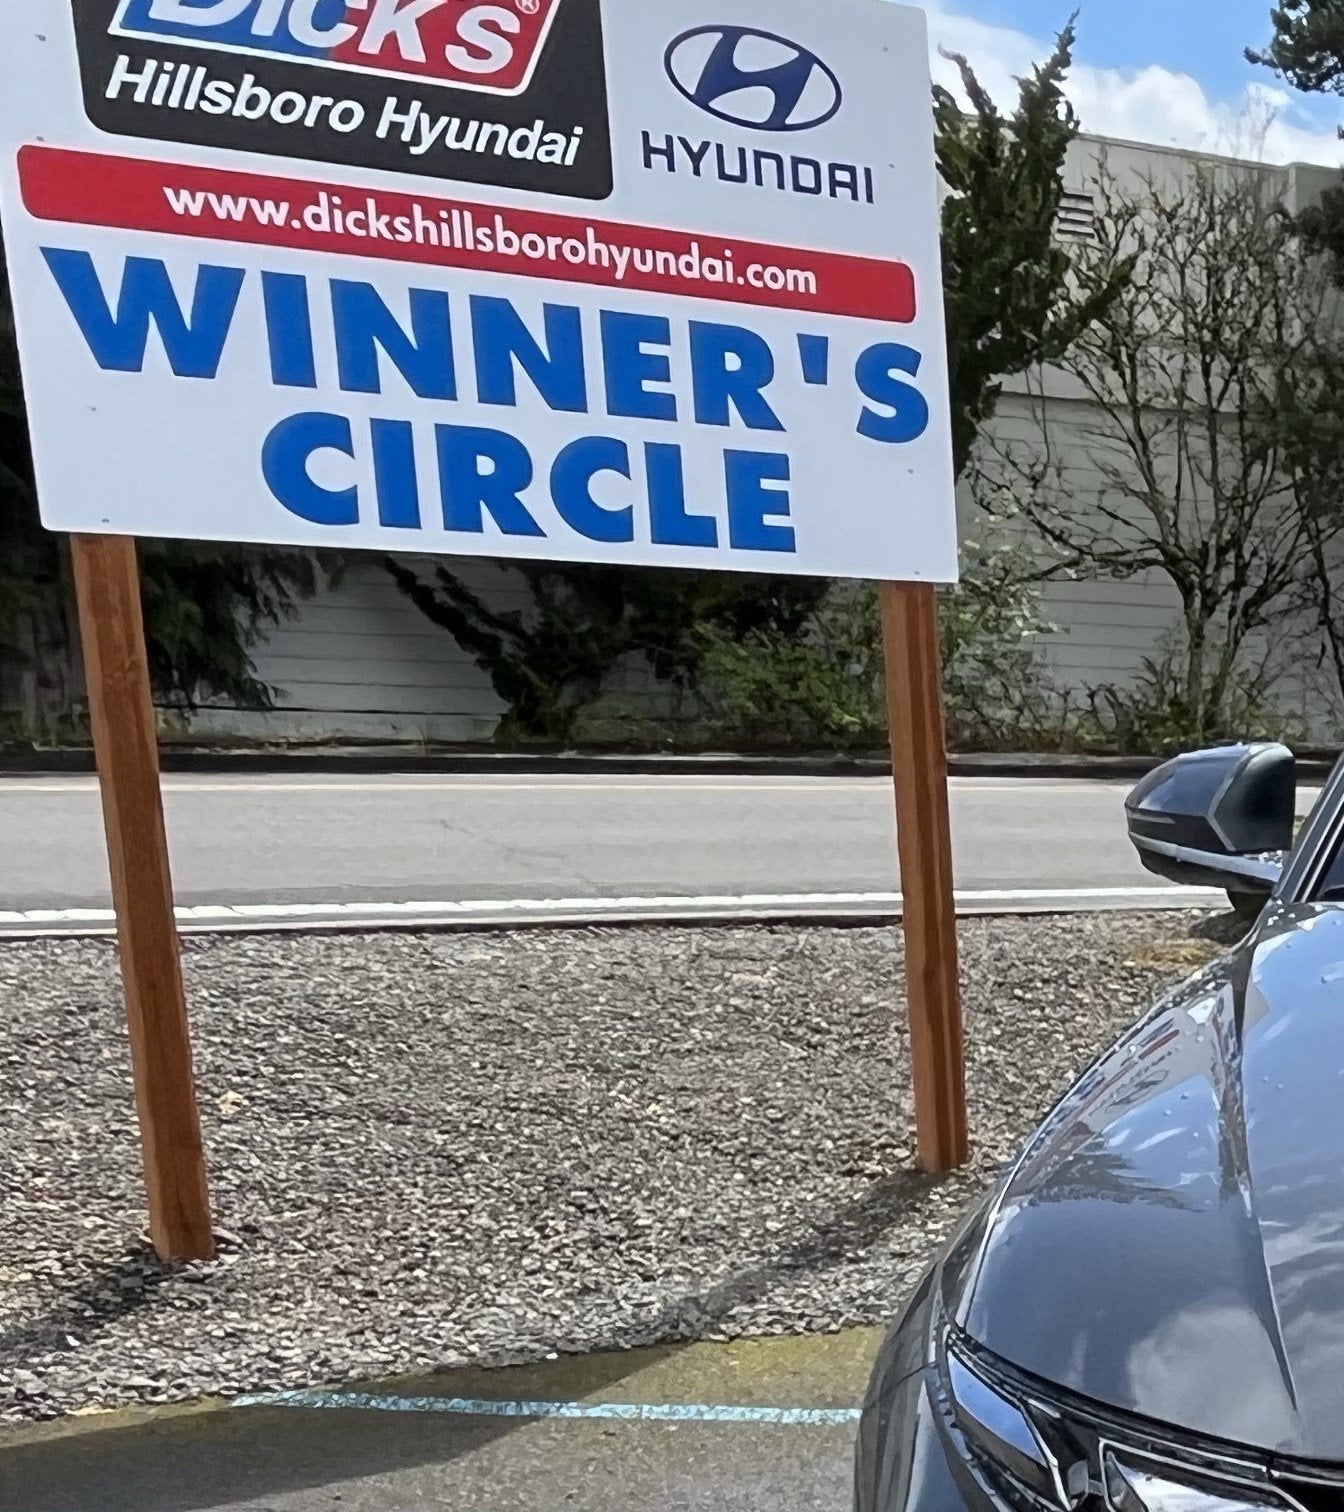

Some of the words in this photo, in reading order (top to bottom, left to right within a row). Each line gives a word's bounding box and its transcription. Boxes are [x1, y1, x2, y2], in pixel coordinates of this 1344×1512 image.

[105, 54, 365, 133] Hillsboro
[375, 96, 584, 167] Hyundai
[641, 130, 875, 205] HYUNDAI
[163, 181, 818, 297] www.dickshillsborohyundai.com
[40, 246, 930, 444] WINNER'S
[261, 411, 796, 553] CIRCLE
